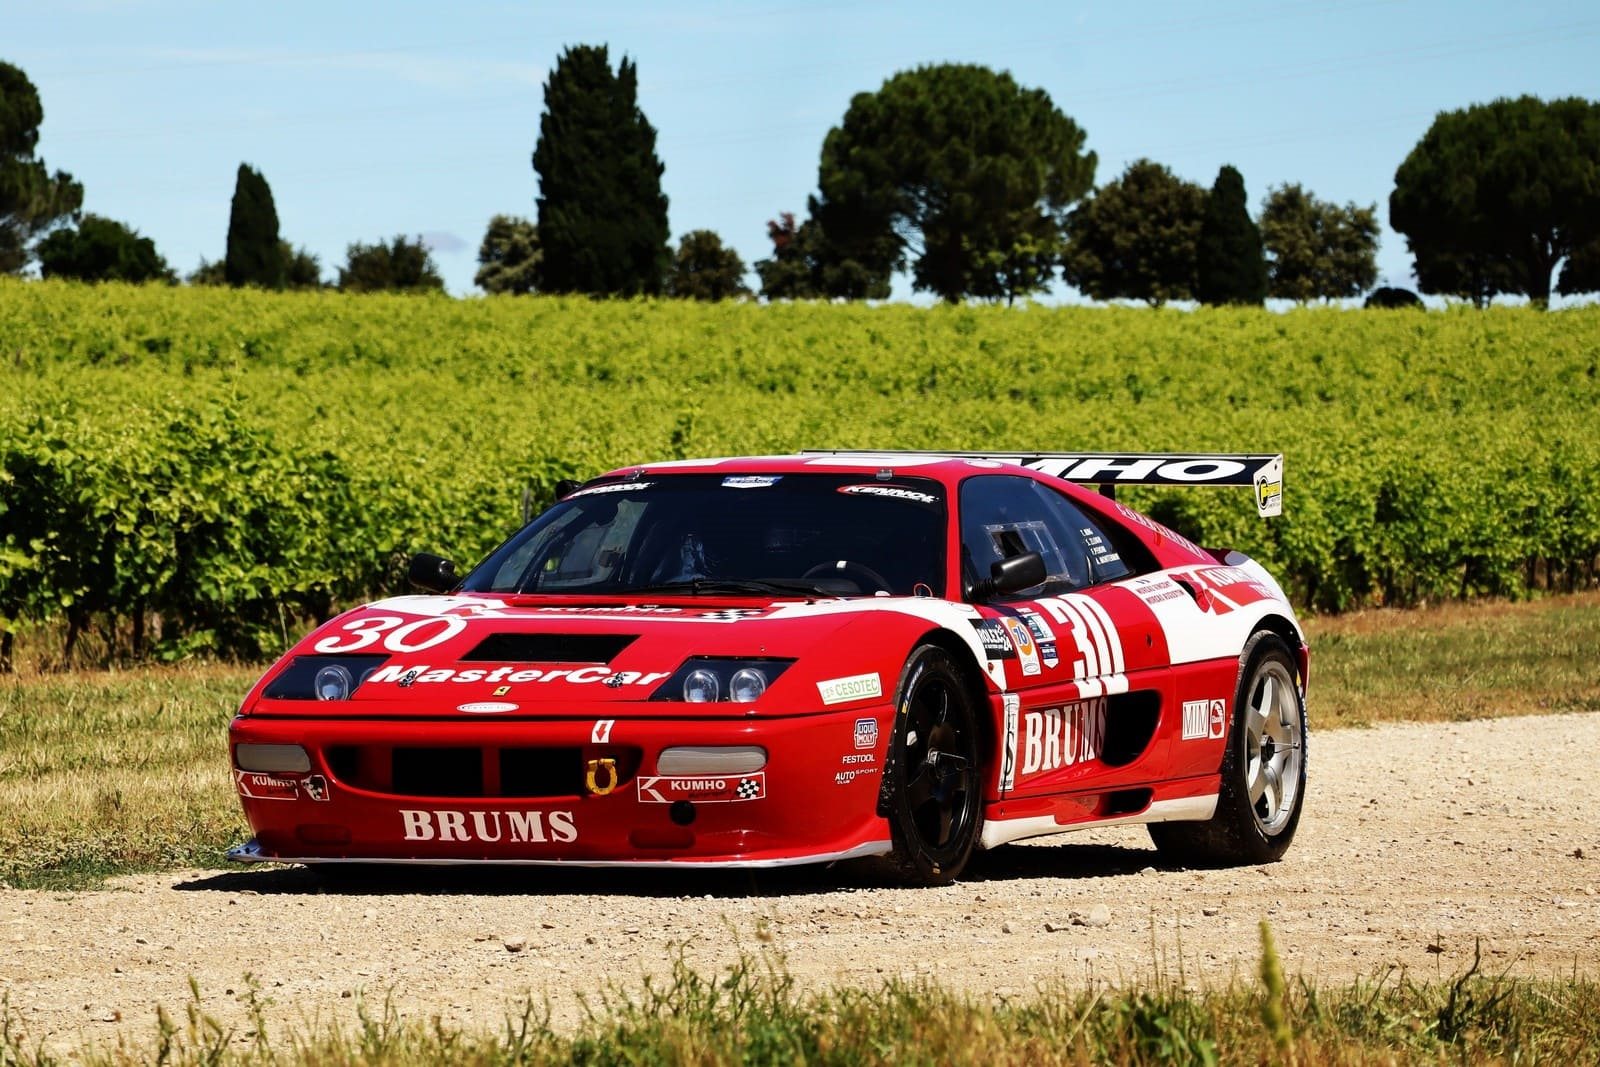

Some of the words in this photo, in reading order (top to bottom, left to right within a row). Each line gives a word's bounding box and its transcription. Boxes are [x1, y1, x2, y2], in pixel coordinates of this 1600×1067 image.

[314, 616, 468, 653] 30
[1012, 625, 1028, 645] 76
[1033, 593, 1129, 699] 30
[367, 665, 672, 687] MasterCar
[835, 679, 878, 696] CESOTEC
[1183, 704, 1207, 735] MIM
[1022, 697, 1107, 775] BRUMS
[842, 753, 875, 764] FESTOOL
[671, 780, 726, 790] KUMHO
[835, 771, 855, 781] AUTO
[399, 810, 577, 843] BRUMS
